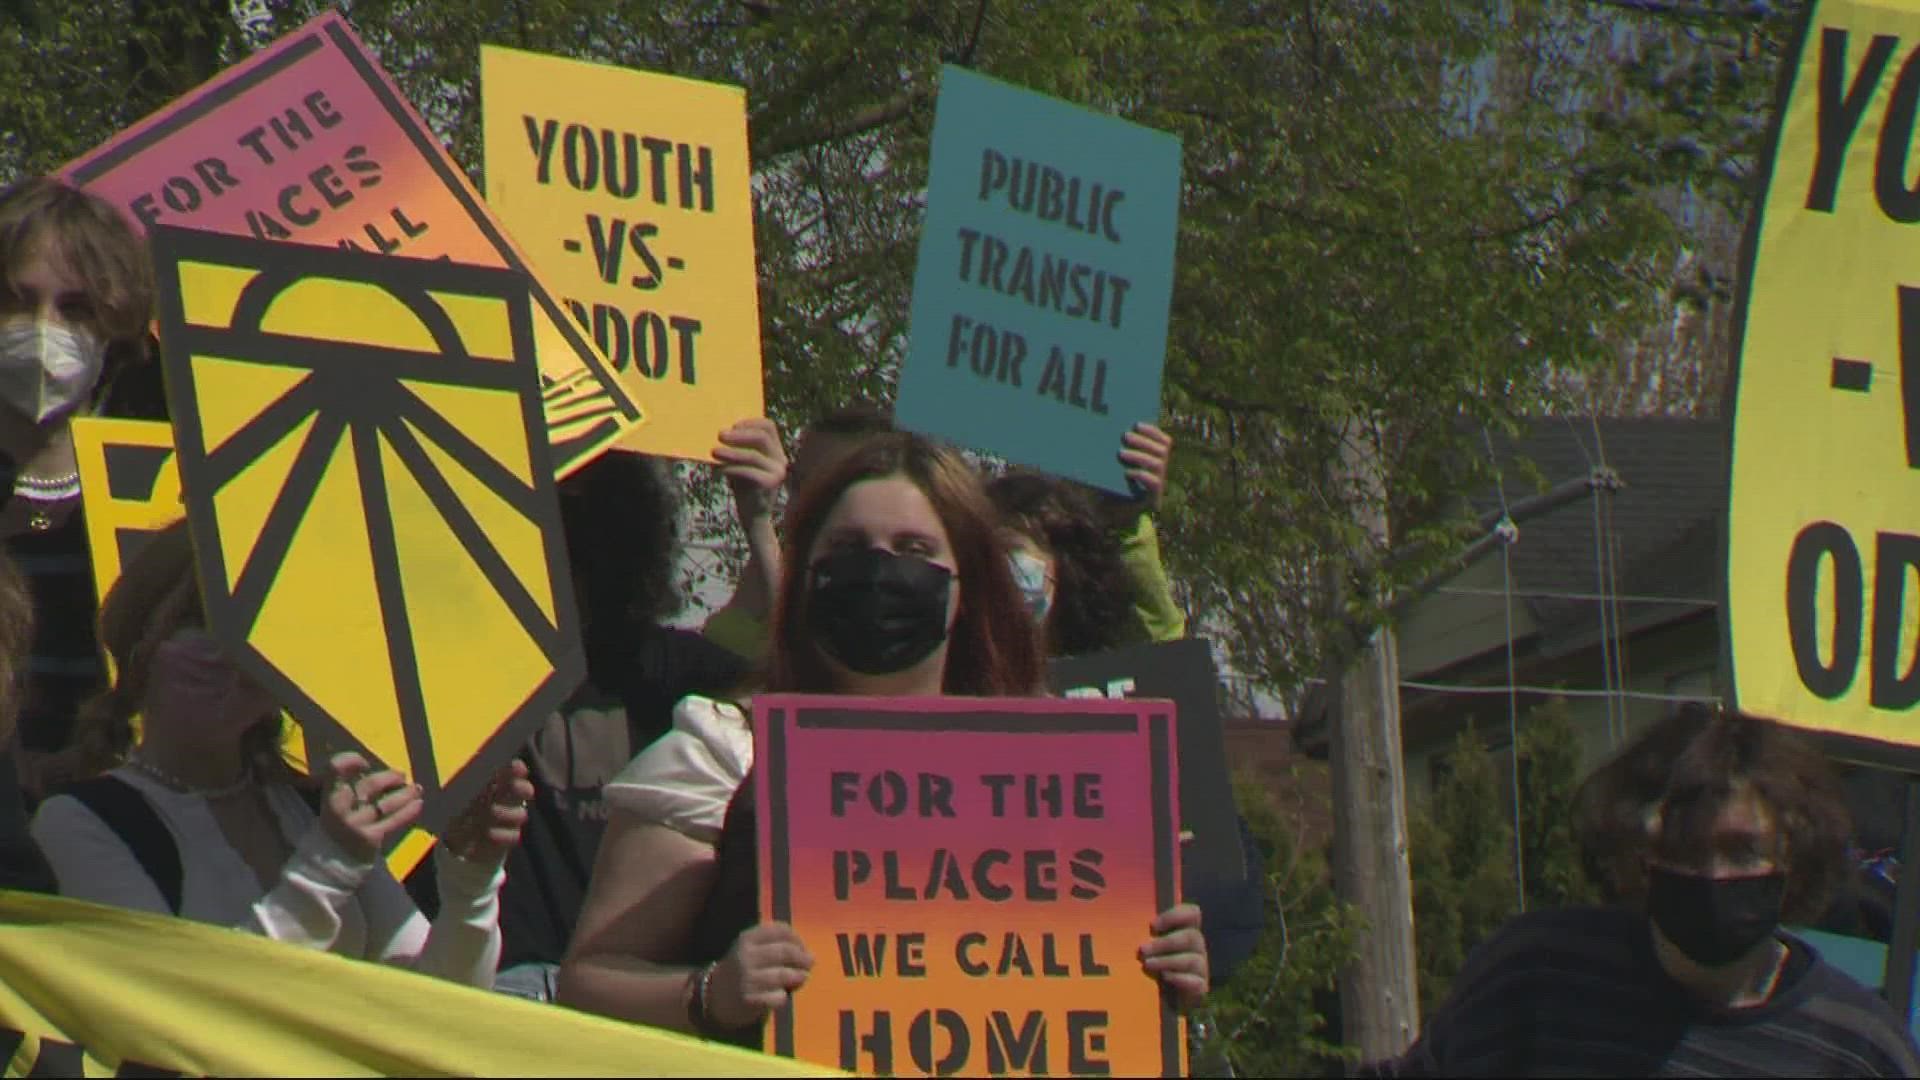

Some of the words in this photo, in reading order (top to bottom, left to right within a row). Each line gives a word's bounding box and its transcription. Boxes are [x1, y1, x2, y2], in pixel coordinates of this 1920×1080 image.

[130, 157, 240, 228] FOR
[238, 90, 343, 165] THE
[246, 146, 382, 240] ACES
[522, 114, 714, 213] YOUTH
[979, 147, 1126, 244] PUBLIC
[563, 213, 685, 290] -VS-
[958, 226, 1132, 329] TRANSIT
[563, 297, 702, 385] DOT
[947, 313, 1028, 388] FOR
[1037, 344, 1109, 415] ALL
[830, 771, 955, 819] FOR
[981, 773, 1105, 819] THE
[833, 848, 1106, 901] PLACES
[836, 932, 926, 978] WE
[955, 931, 1110, 978] CALL
[838, 1008, 1111, 1077] HOME
